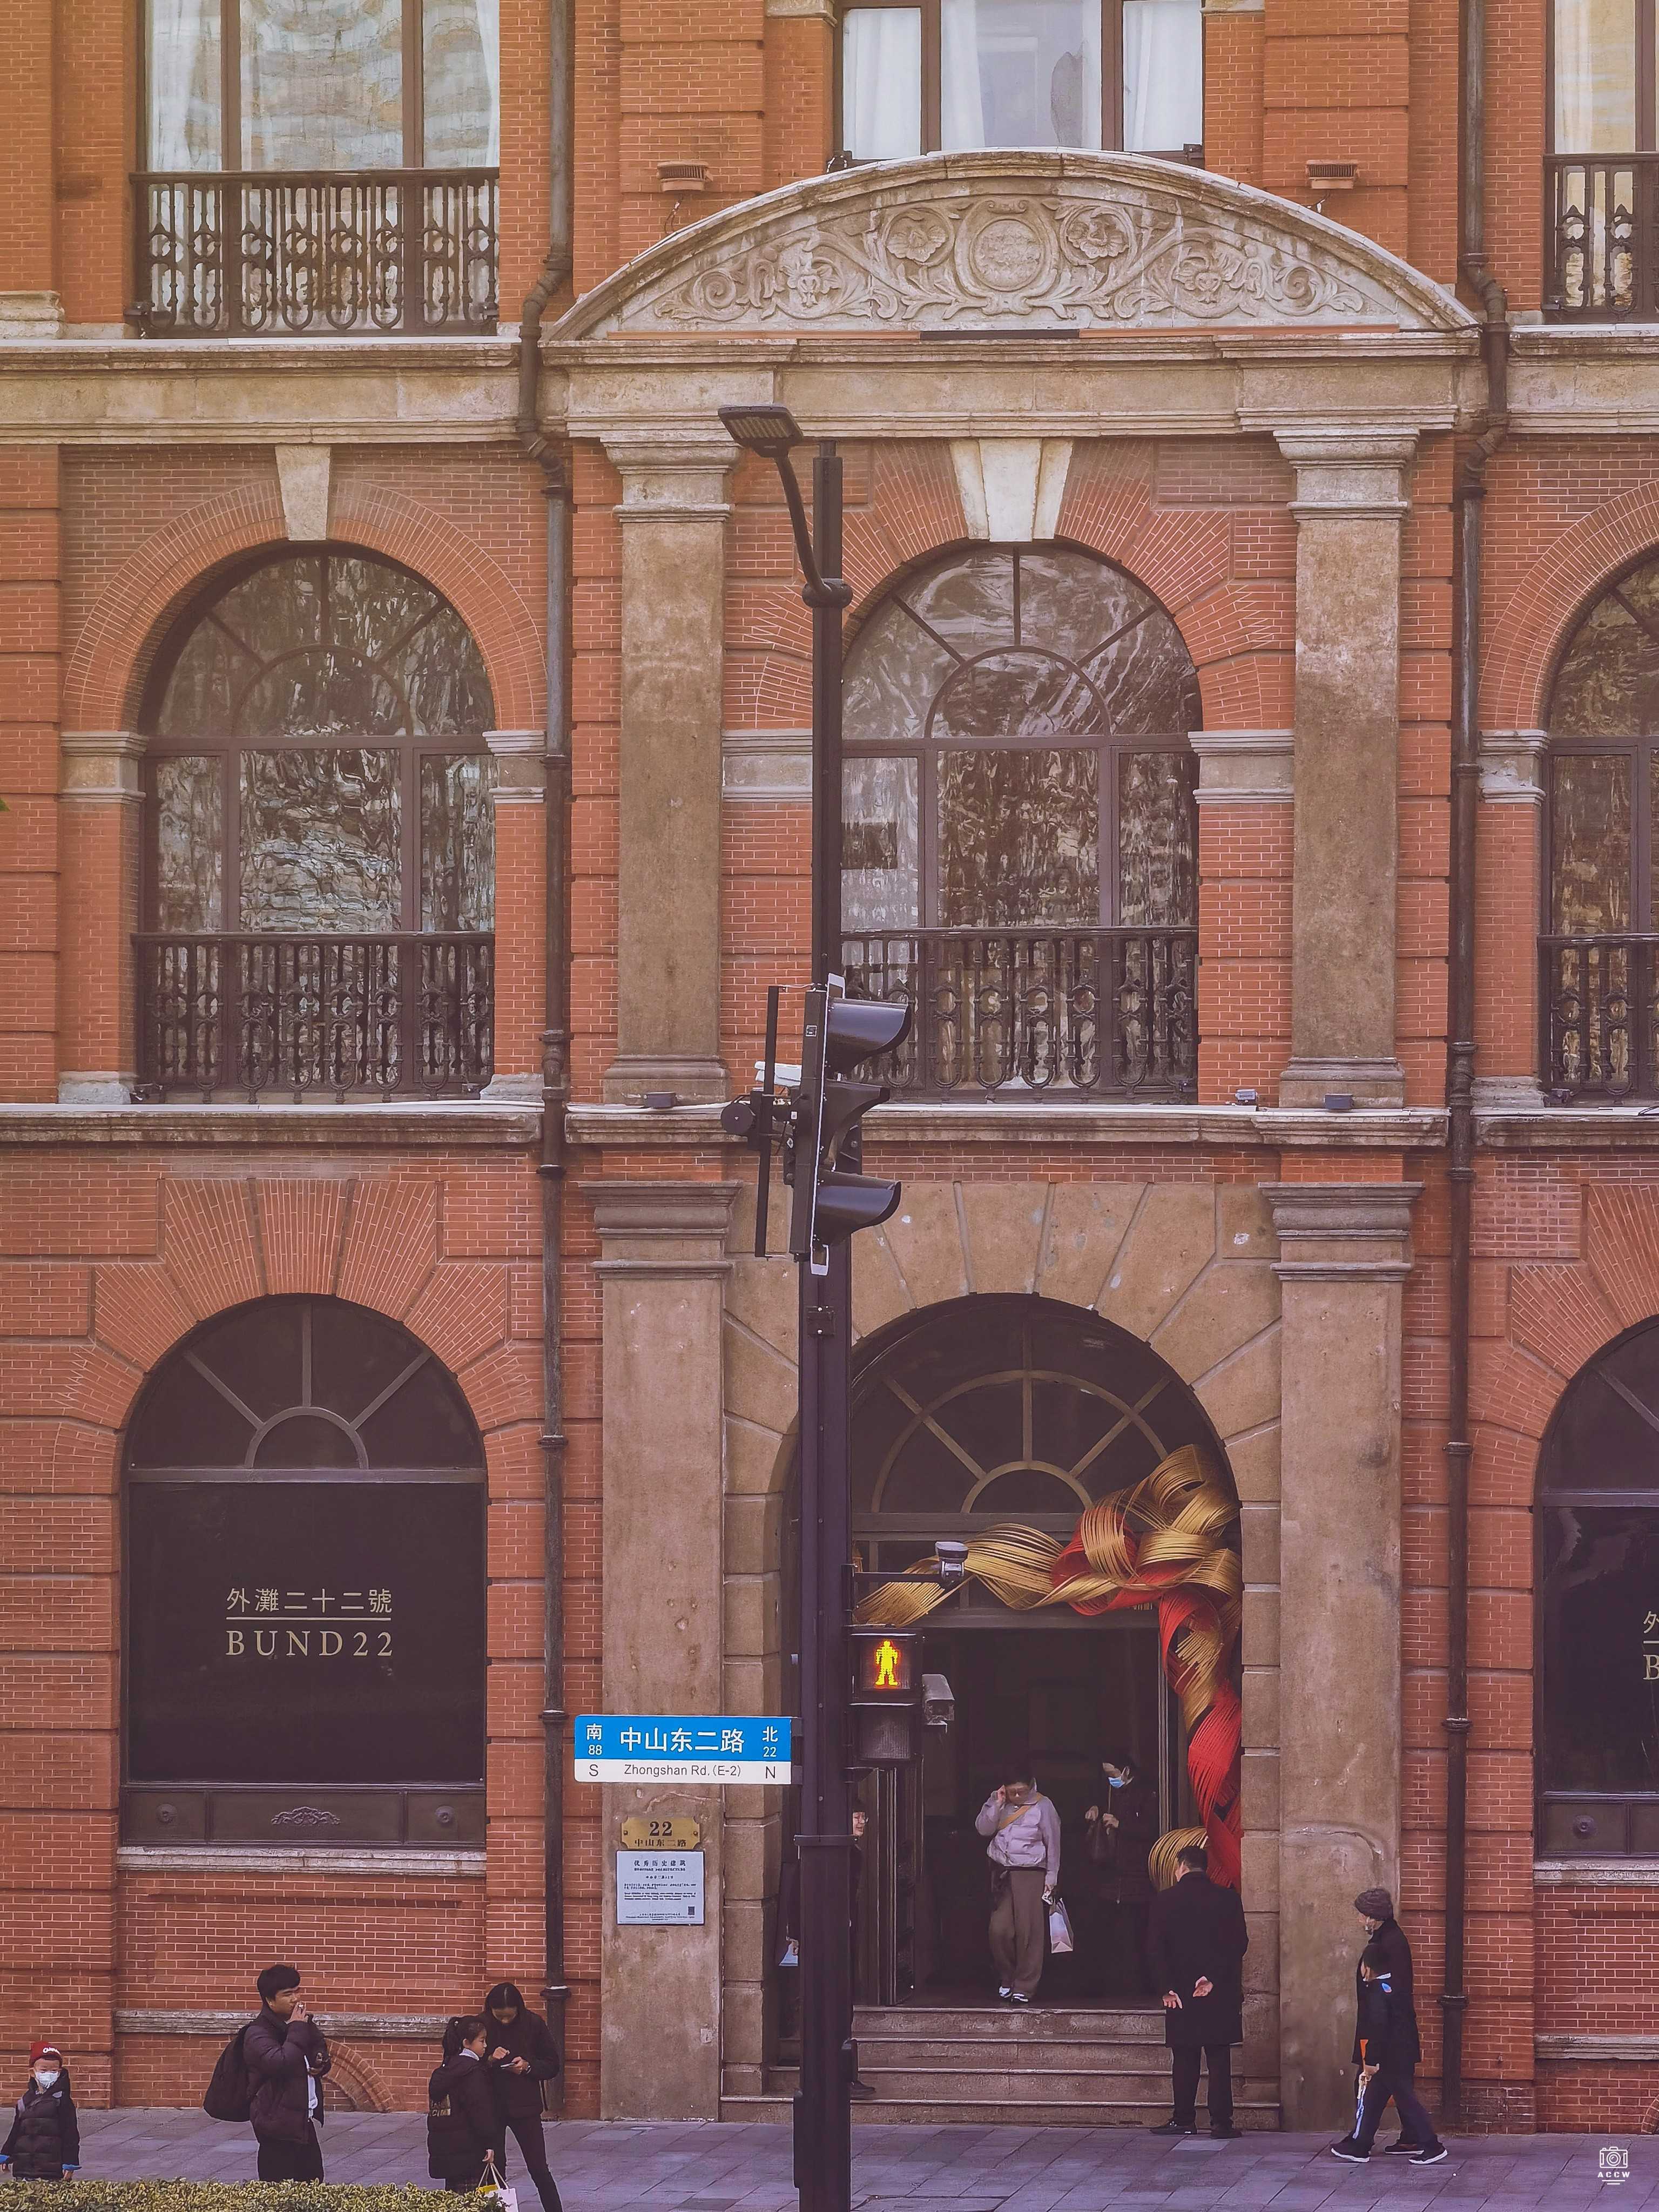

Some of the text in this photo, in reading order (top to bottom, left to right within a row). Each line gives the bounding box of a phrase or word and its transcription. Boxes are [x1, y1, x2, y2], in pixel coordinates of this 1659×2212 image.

[227, 1588, 392, 1613] 外灘二十二號
[586, 1723, 602, 1741] 南
[762, 1726, 778, 1743] 北
[620, 1727, 745, 1753] 中山东二路
[588, 1744, 602, 1756] 88
[763, 1746, 777, 1758] 22
[589, 1764, 598, 1777] S
[624, 1764, 687, 1777] Zhongshan
[765, 1766, 776, 1779] N
[650, 1821, 672, 1836] 22
[635, 1838, 686, 1847] 中山东二路
